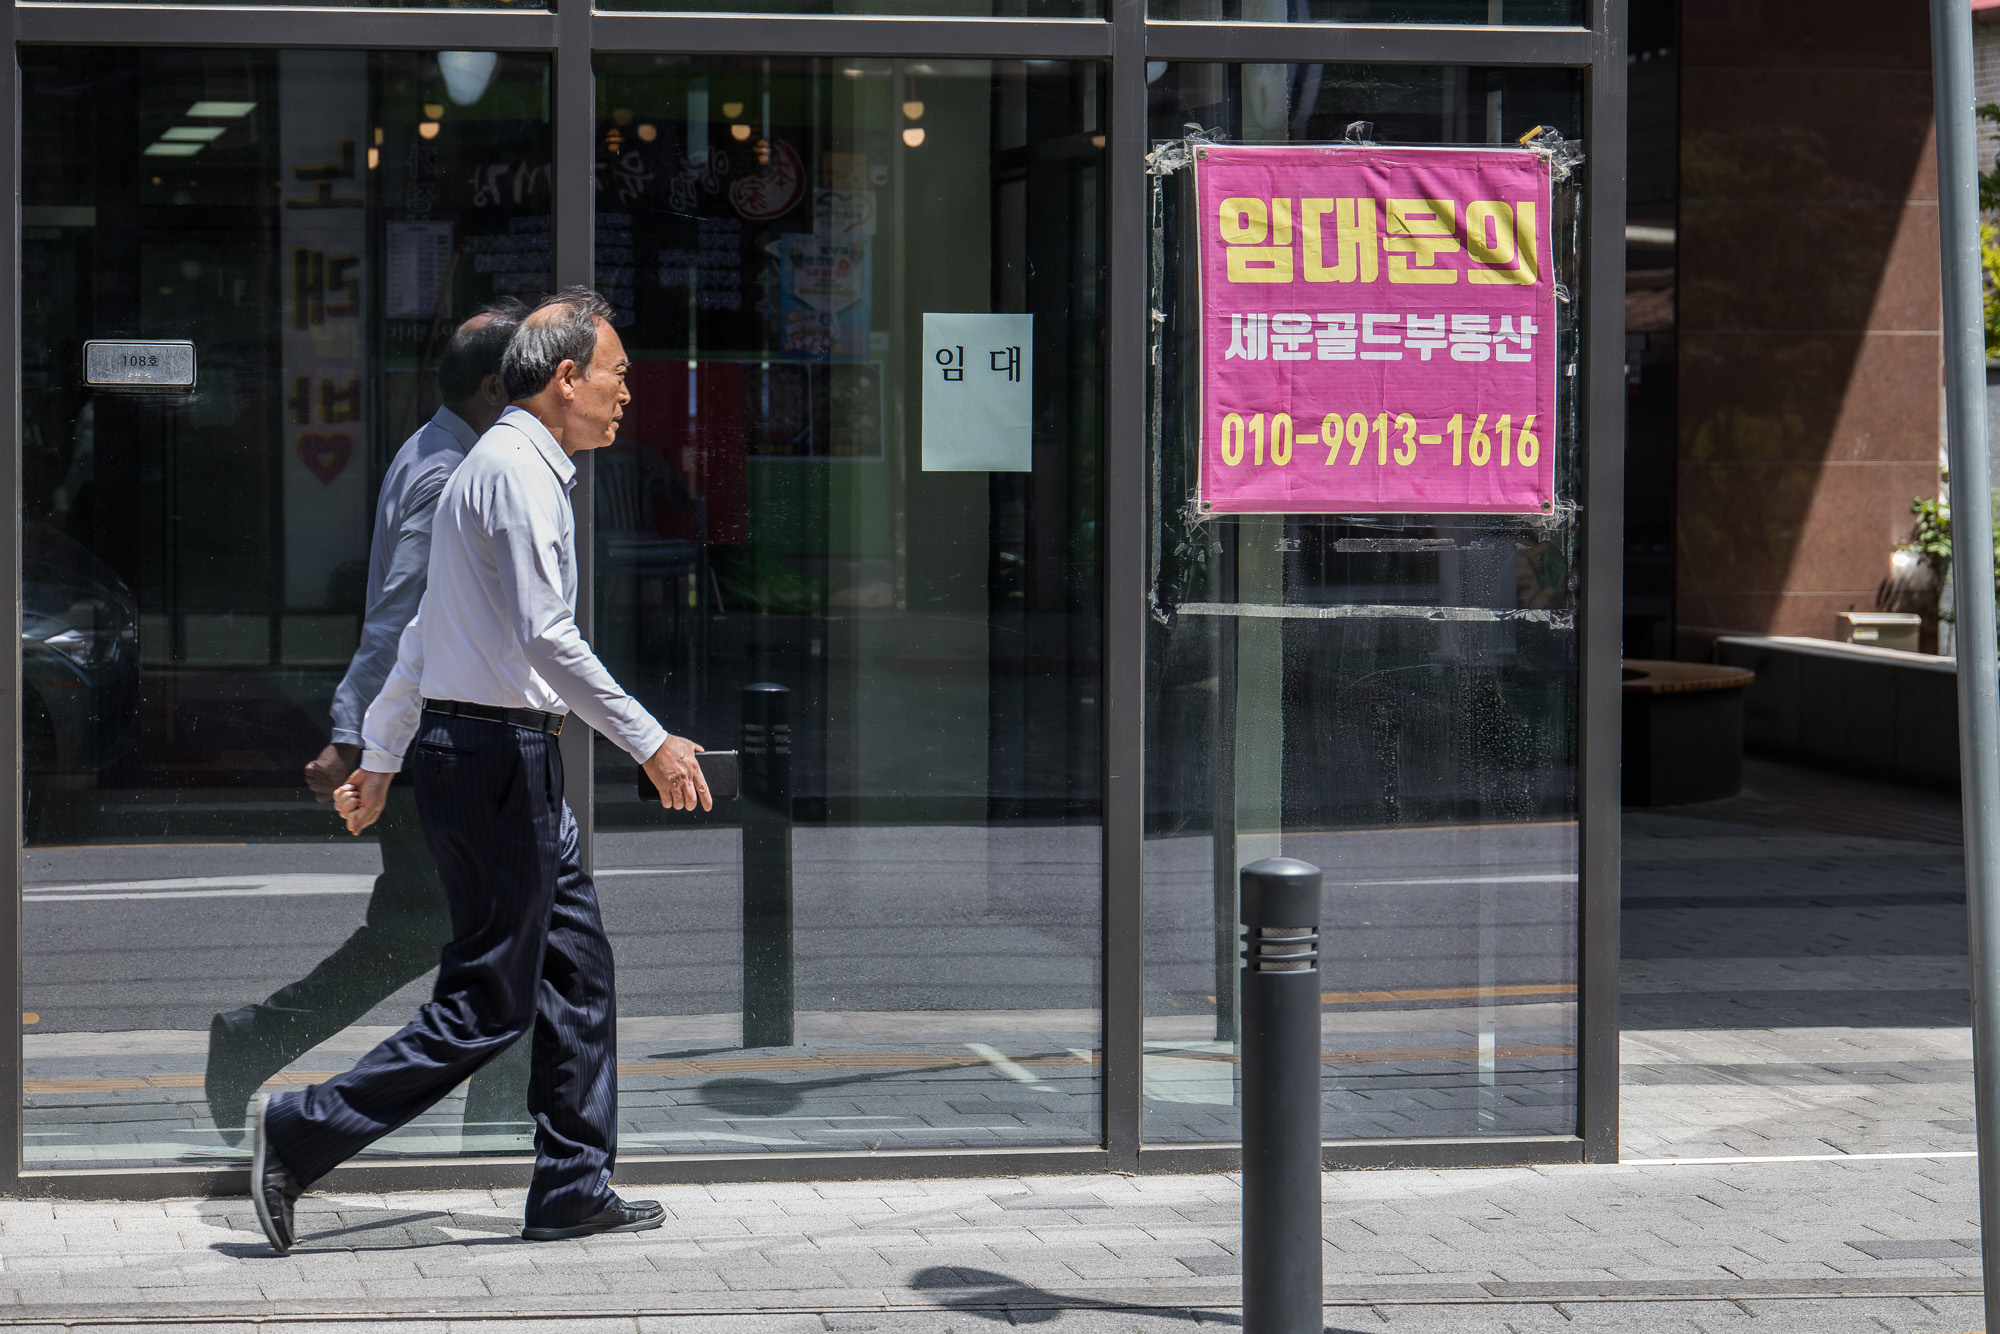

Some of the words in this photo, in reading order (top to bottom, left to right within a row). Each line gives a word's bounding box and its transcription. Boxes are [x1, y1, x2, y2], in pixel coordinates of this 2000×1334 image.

[1218, 196, 1538, 286] 임대문의
[122, 355, 159, 367] 108호
[1224, 311, 1538, 363] 세운골드부동산
[1220, 411, 1541, 468] 010-9913-1616
